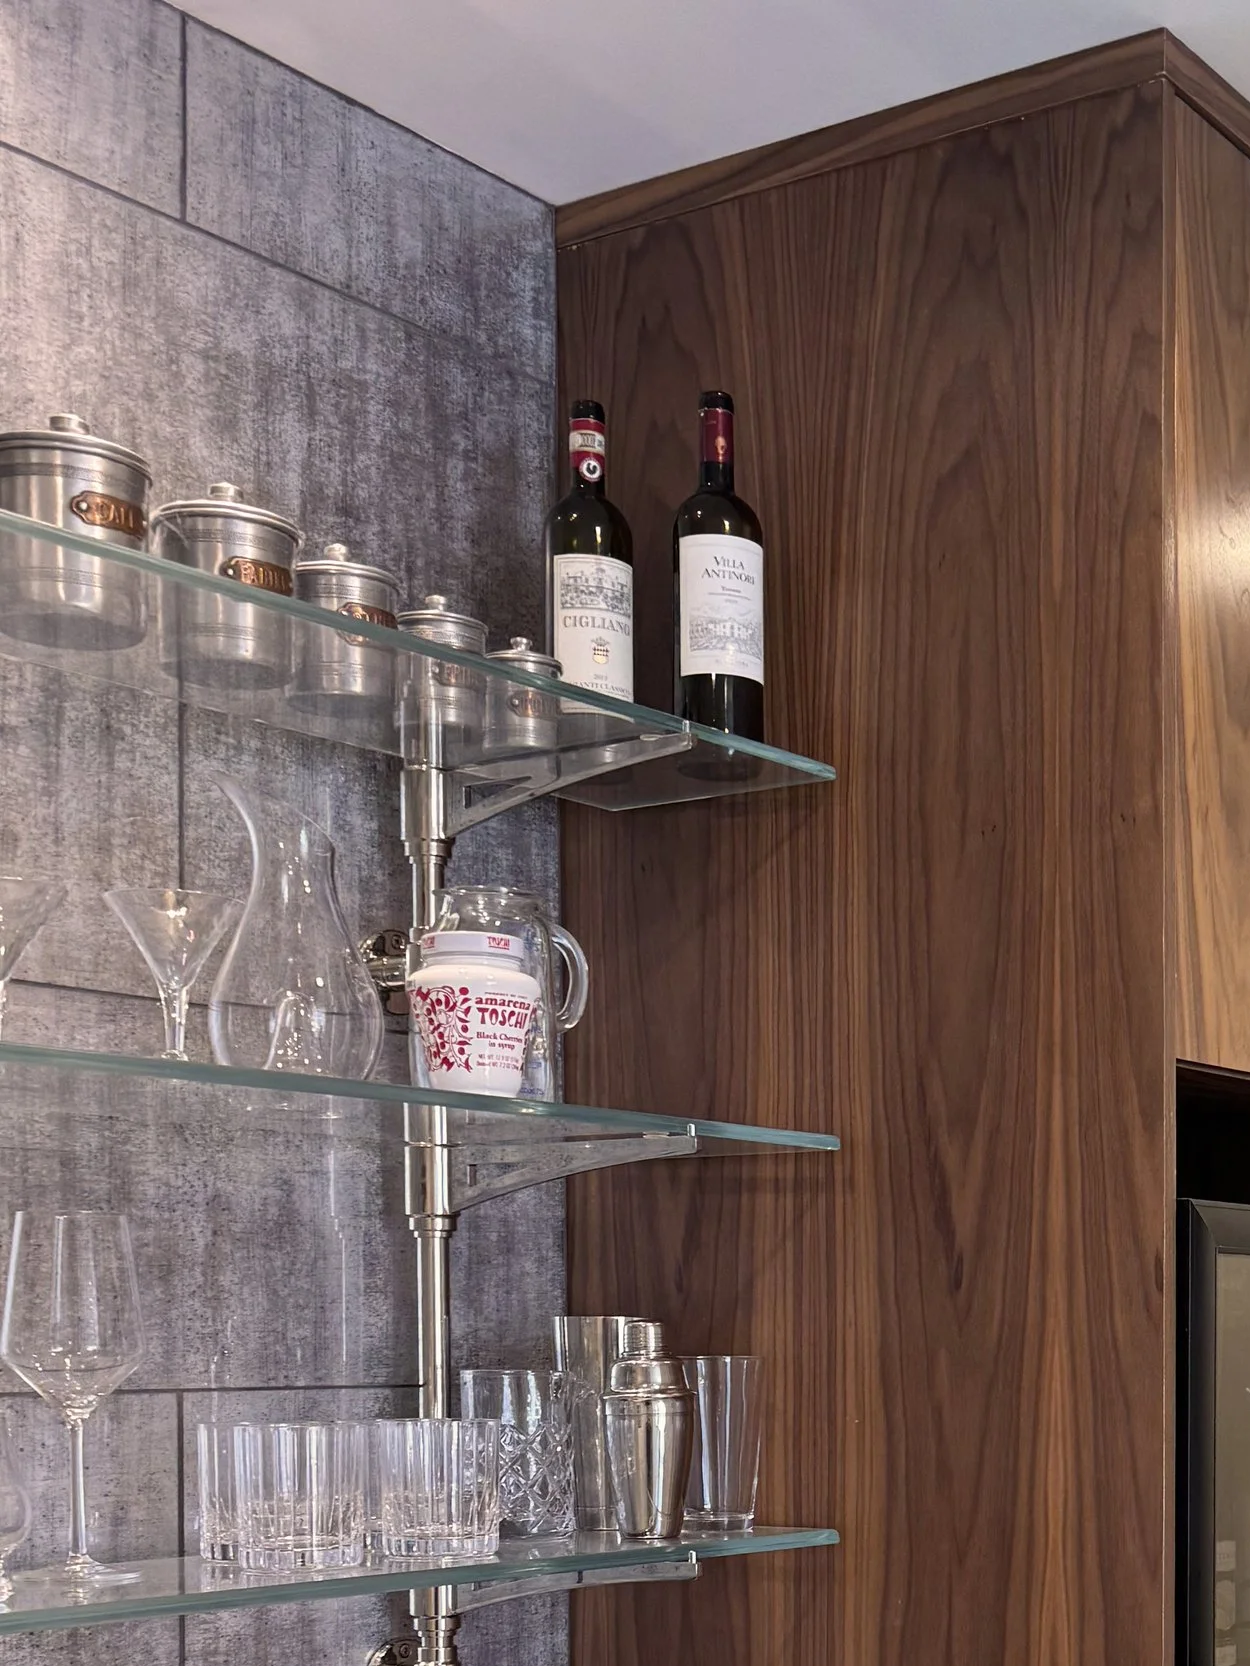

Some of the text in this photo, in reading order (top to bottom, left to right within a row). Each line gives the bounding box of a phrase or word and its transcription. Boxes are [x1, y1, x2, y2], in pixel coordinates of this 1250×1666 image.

[713, 556, 745, 570] VILLA
[702, 568, 755, 585] ANTINORI
[563, 615, 631, 636] CIGLIANO
[475, 997, 531, 1011] amarena
[476, 1007, 529, 1030] TOSCHI
[476, 1031, 498, 1040] Black
